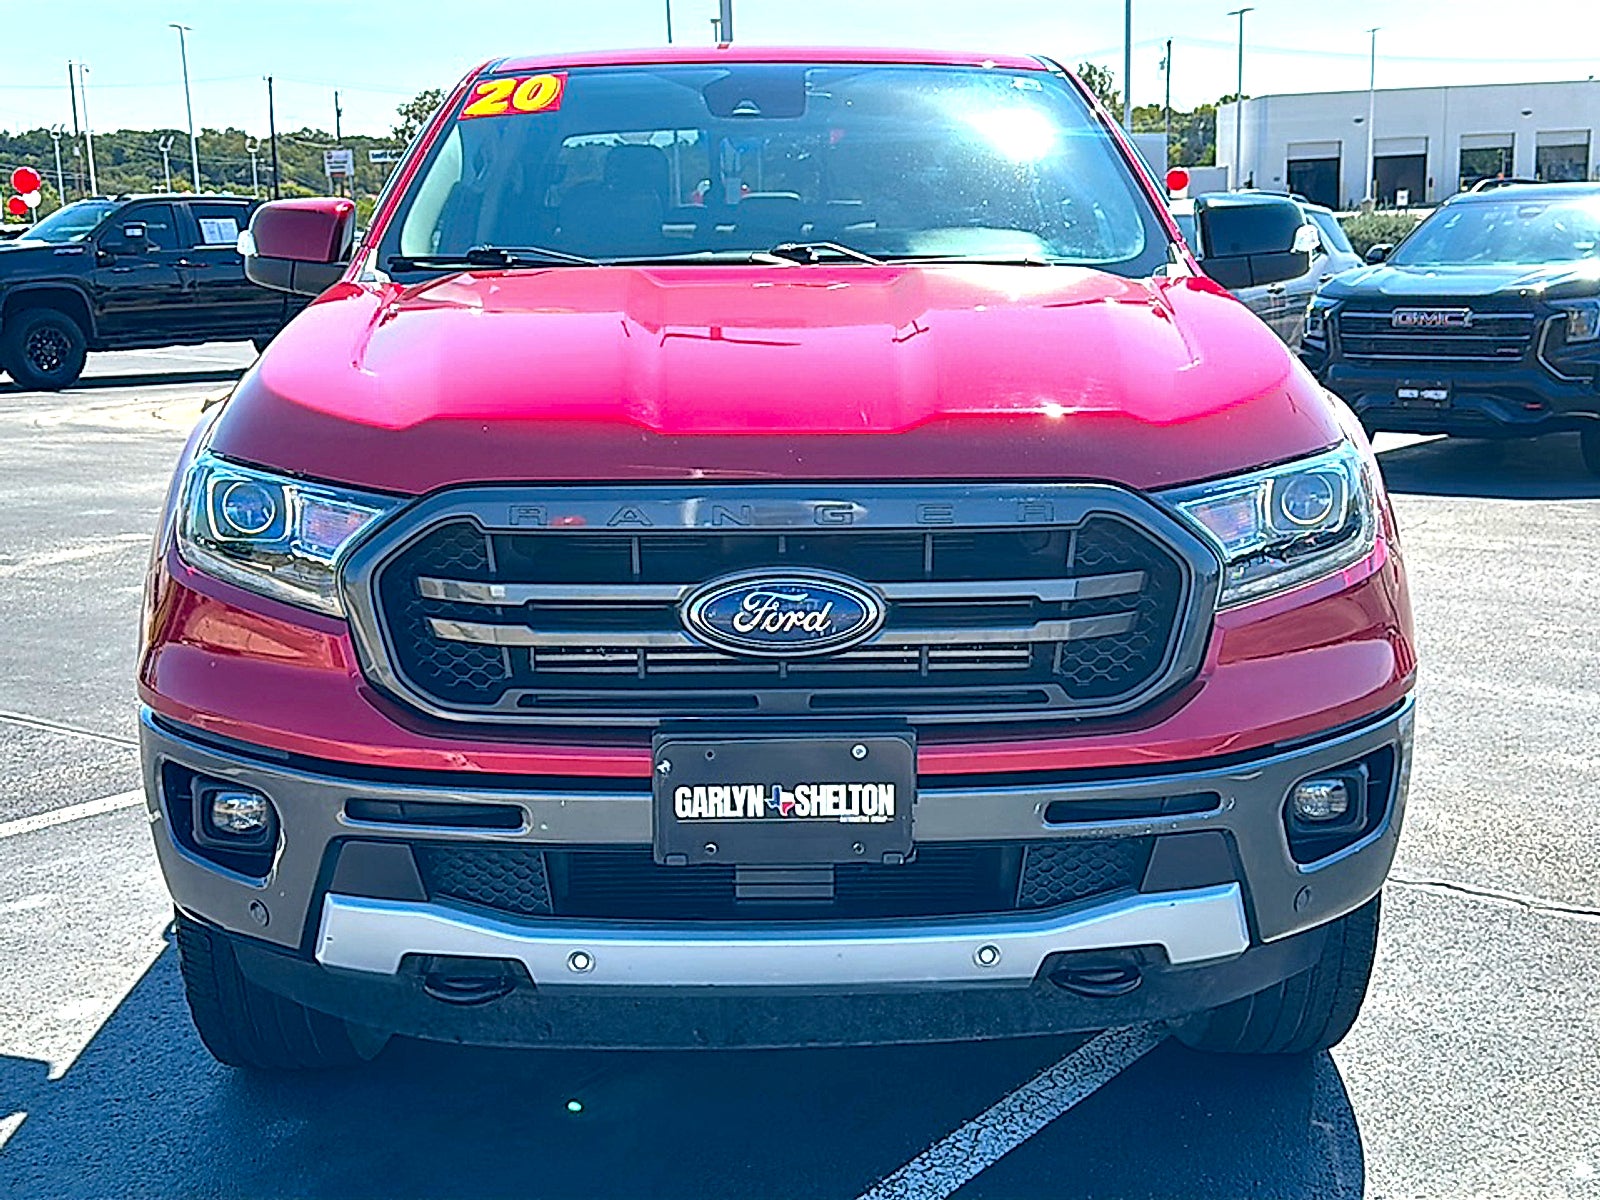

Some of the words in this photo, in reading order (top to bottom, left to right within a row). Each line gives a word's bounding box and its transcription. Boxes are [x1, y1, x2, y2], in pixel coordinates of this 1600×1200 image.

[463, 74, 561, 115] 20
[1394, 309, 1471, 327] GMC
[508, 503, 1055, 527] RANGER
[732, 590, 832, 634] Ford
[674, 785, 765, 818] GARLYN
[794, 783, 895, 817] SHELTON
